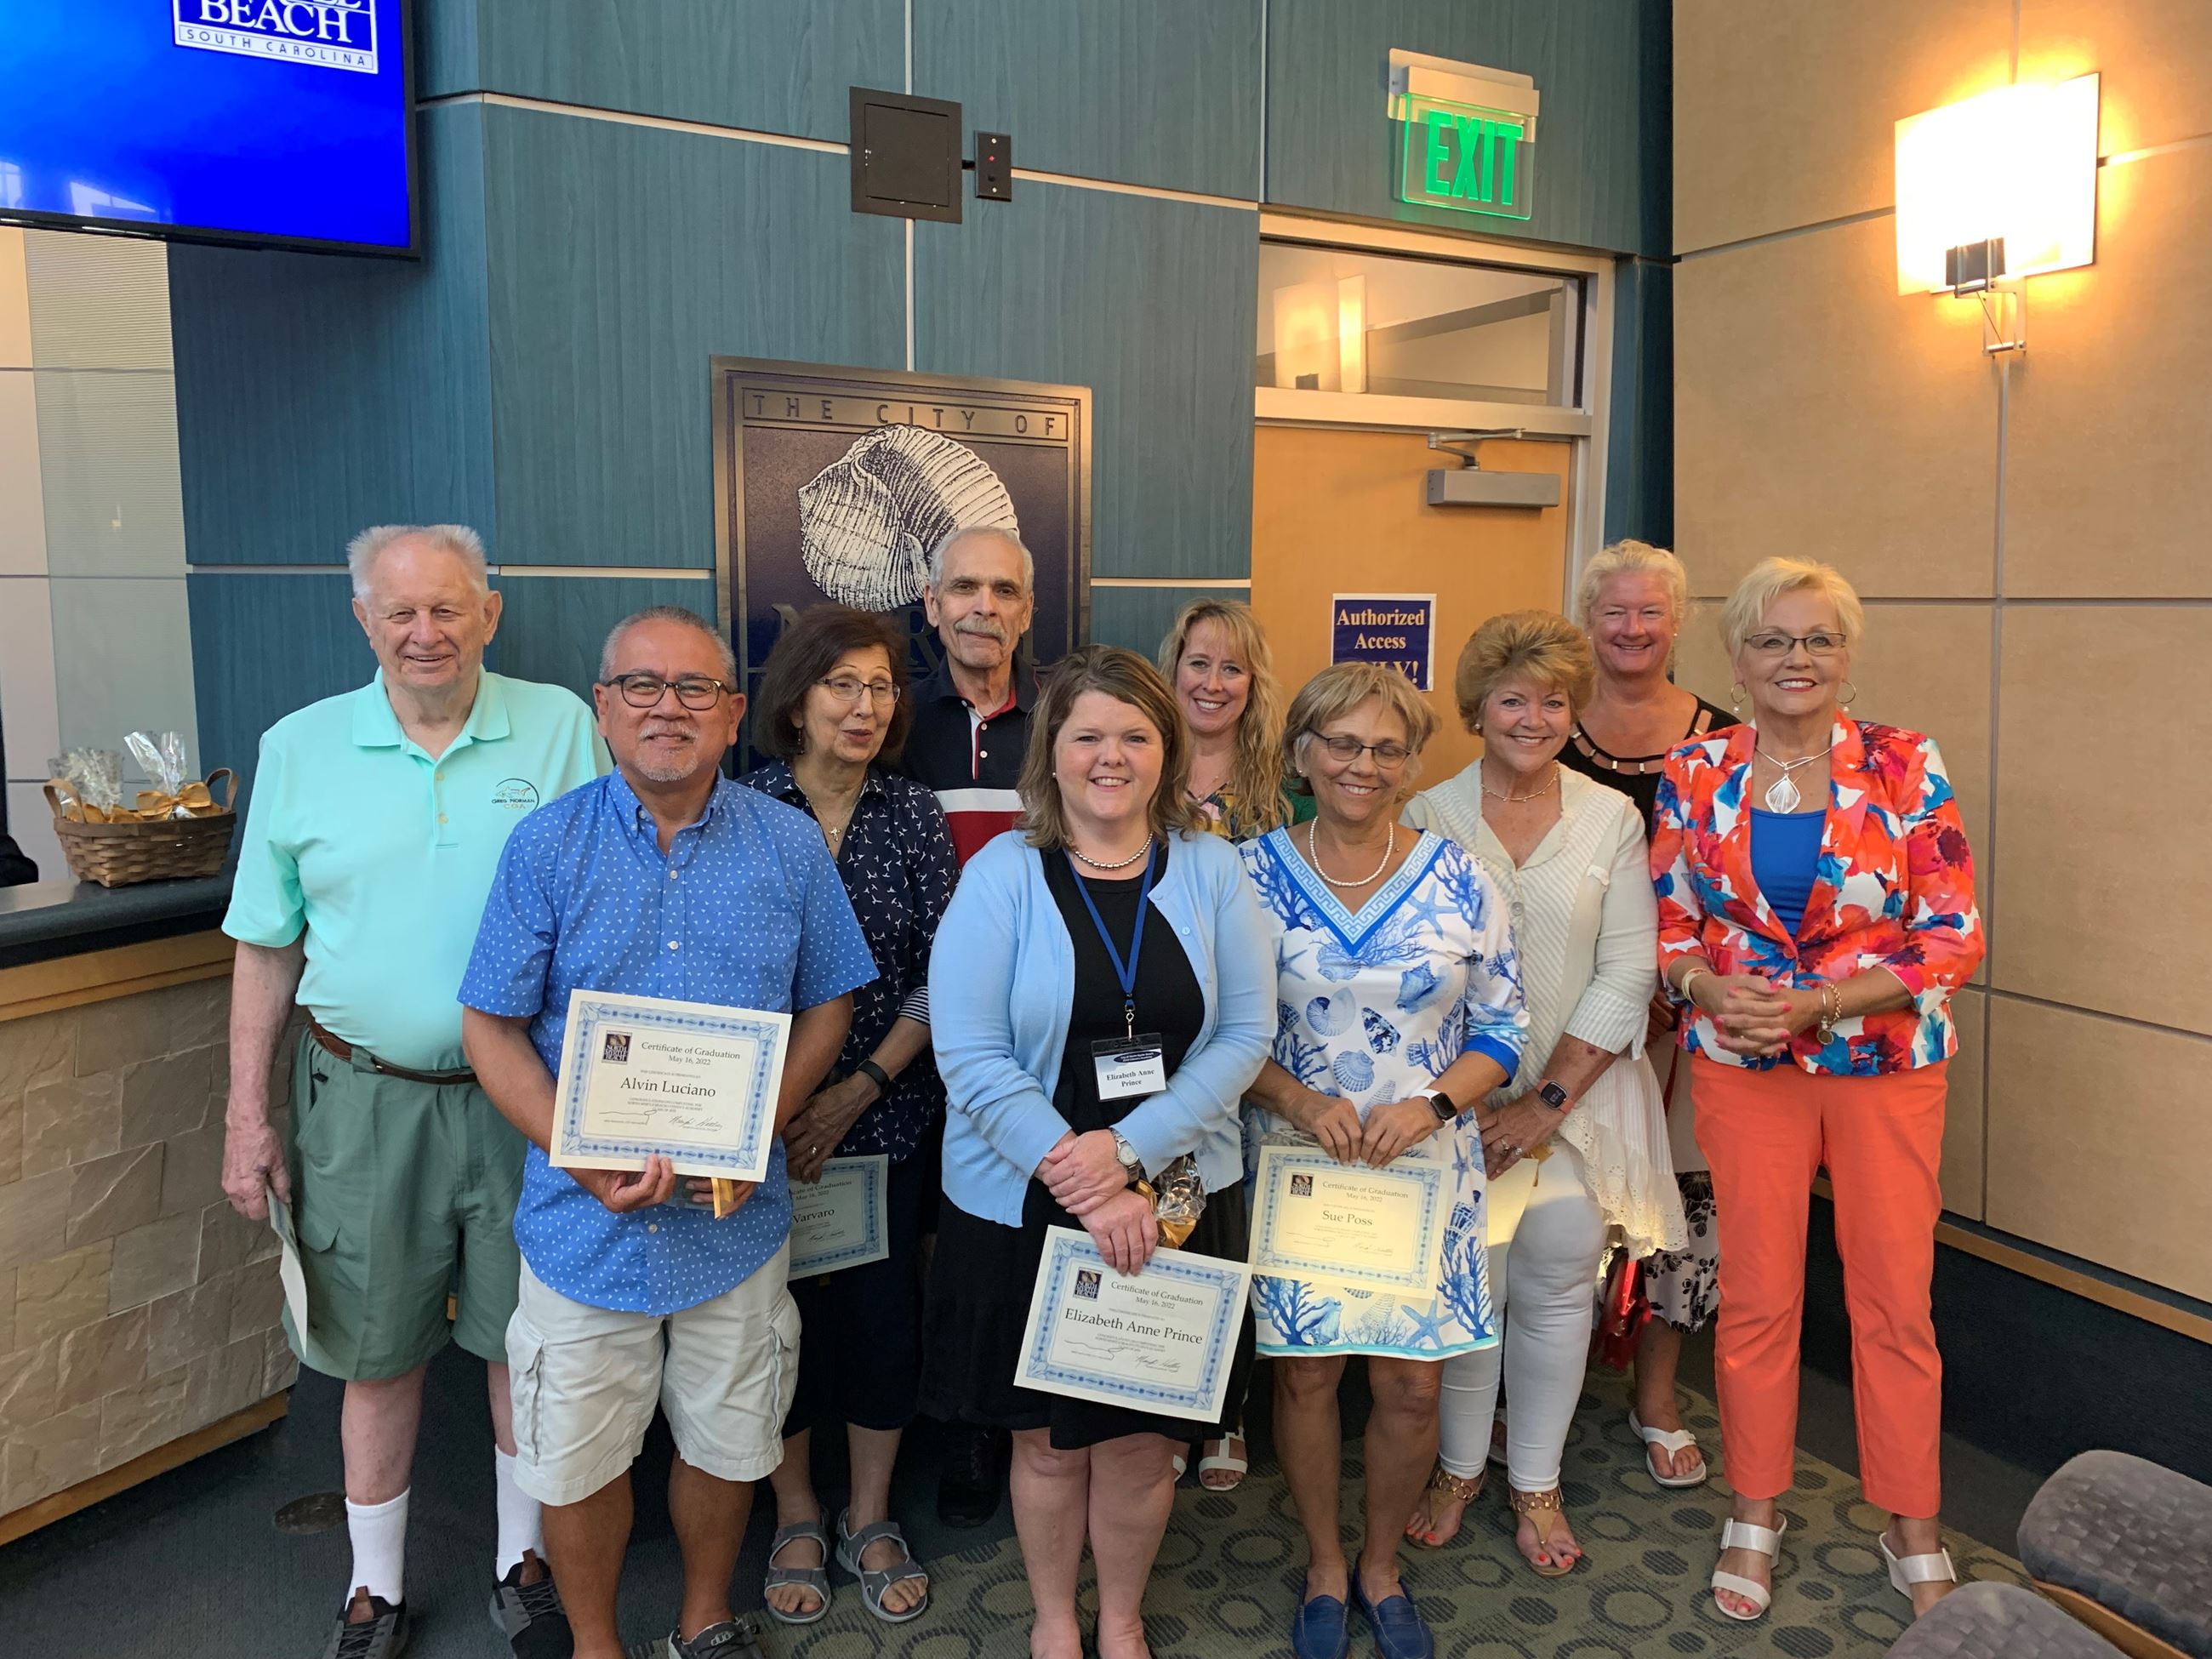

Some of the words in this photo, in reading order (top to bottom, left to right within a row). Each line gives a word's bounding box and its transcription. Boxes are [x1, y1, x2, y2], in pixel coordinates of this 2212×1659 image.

[199, 0, 352, 43] BEACH
[186, 29, 251, 48] SOUTH
[265, 41, 365, 66] CAROLINA
[1425, 109, 1524, 205] EXIT
[752, 394, 832, 420] THE
[876, 404, 976, 430] CITY
[1014, 414, 1055, 436] OF
[1336, 608, 1425, 625] Authorized
[1354, 632, 1407, 649] Access
[641, 1041, 683, 1053] Certificate
[694, 1047, 741, 1059] Graduation
[668, 1055, 682, 1064] May
[1106, 1070, 1137, 1081] Elizabeth
[620, 1076, 658, 1092] Alvin
[662, 1080, 716, 1097] Luciano
[1322, 1180, 1359, 1193] Certificate
[1360, 1184, 1367, 1193] of
[1368, 1187, 1409, 1199] Graduation
[793, 1208, 835, 1223] Varvaro
[1322, 1210, 1344, 1223] Sue
[1347, 1213, 1373, 1226] Poss
[1110, 1280, 1149, 1296] Certificate
[1151, 1288, 1160, 1297] of
[1160, 1291, 1204, 1306] Graduation
[1136, 1296, 1149, 1305] May
[1161, 1301, 1176, 1309] 2022
[1064, 1308, 1123, 1330] Elizabeth
[1126, 1320, 1160, 1337] Anne
[1163, 1326, 1203, 1344] Prince
